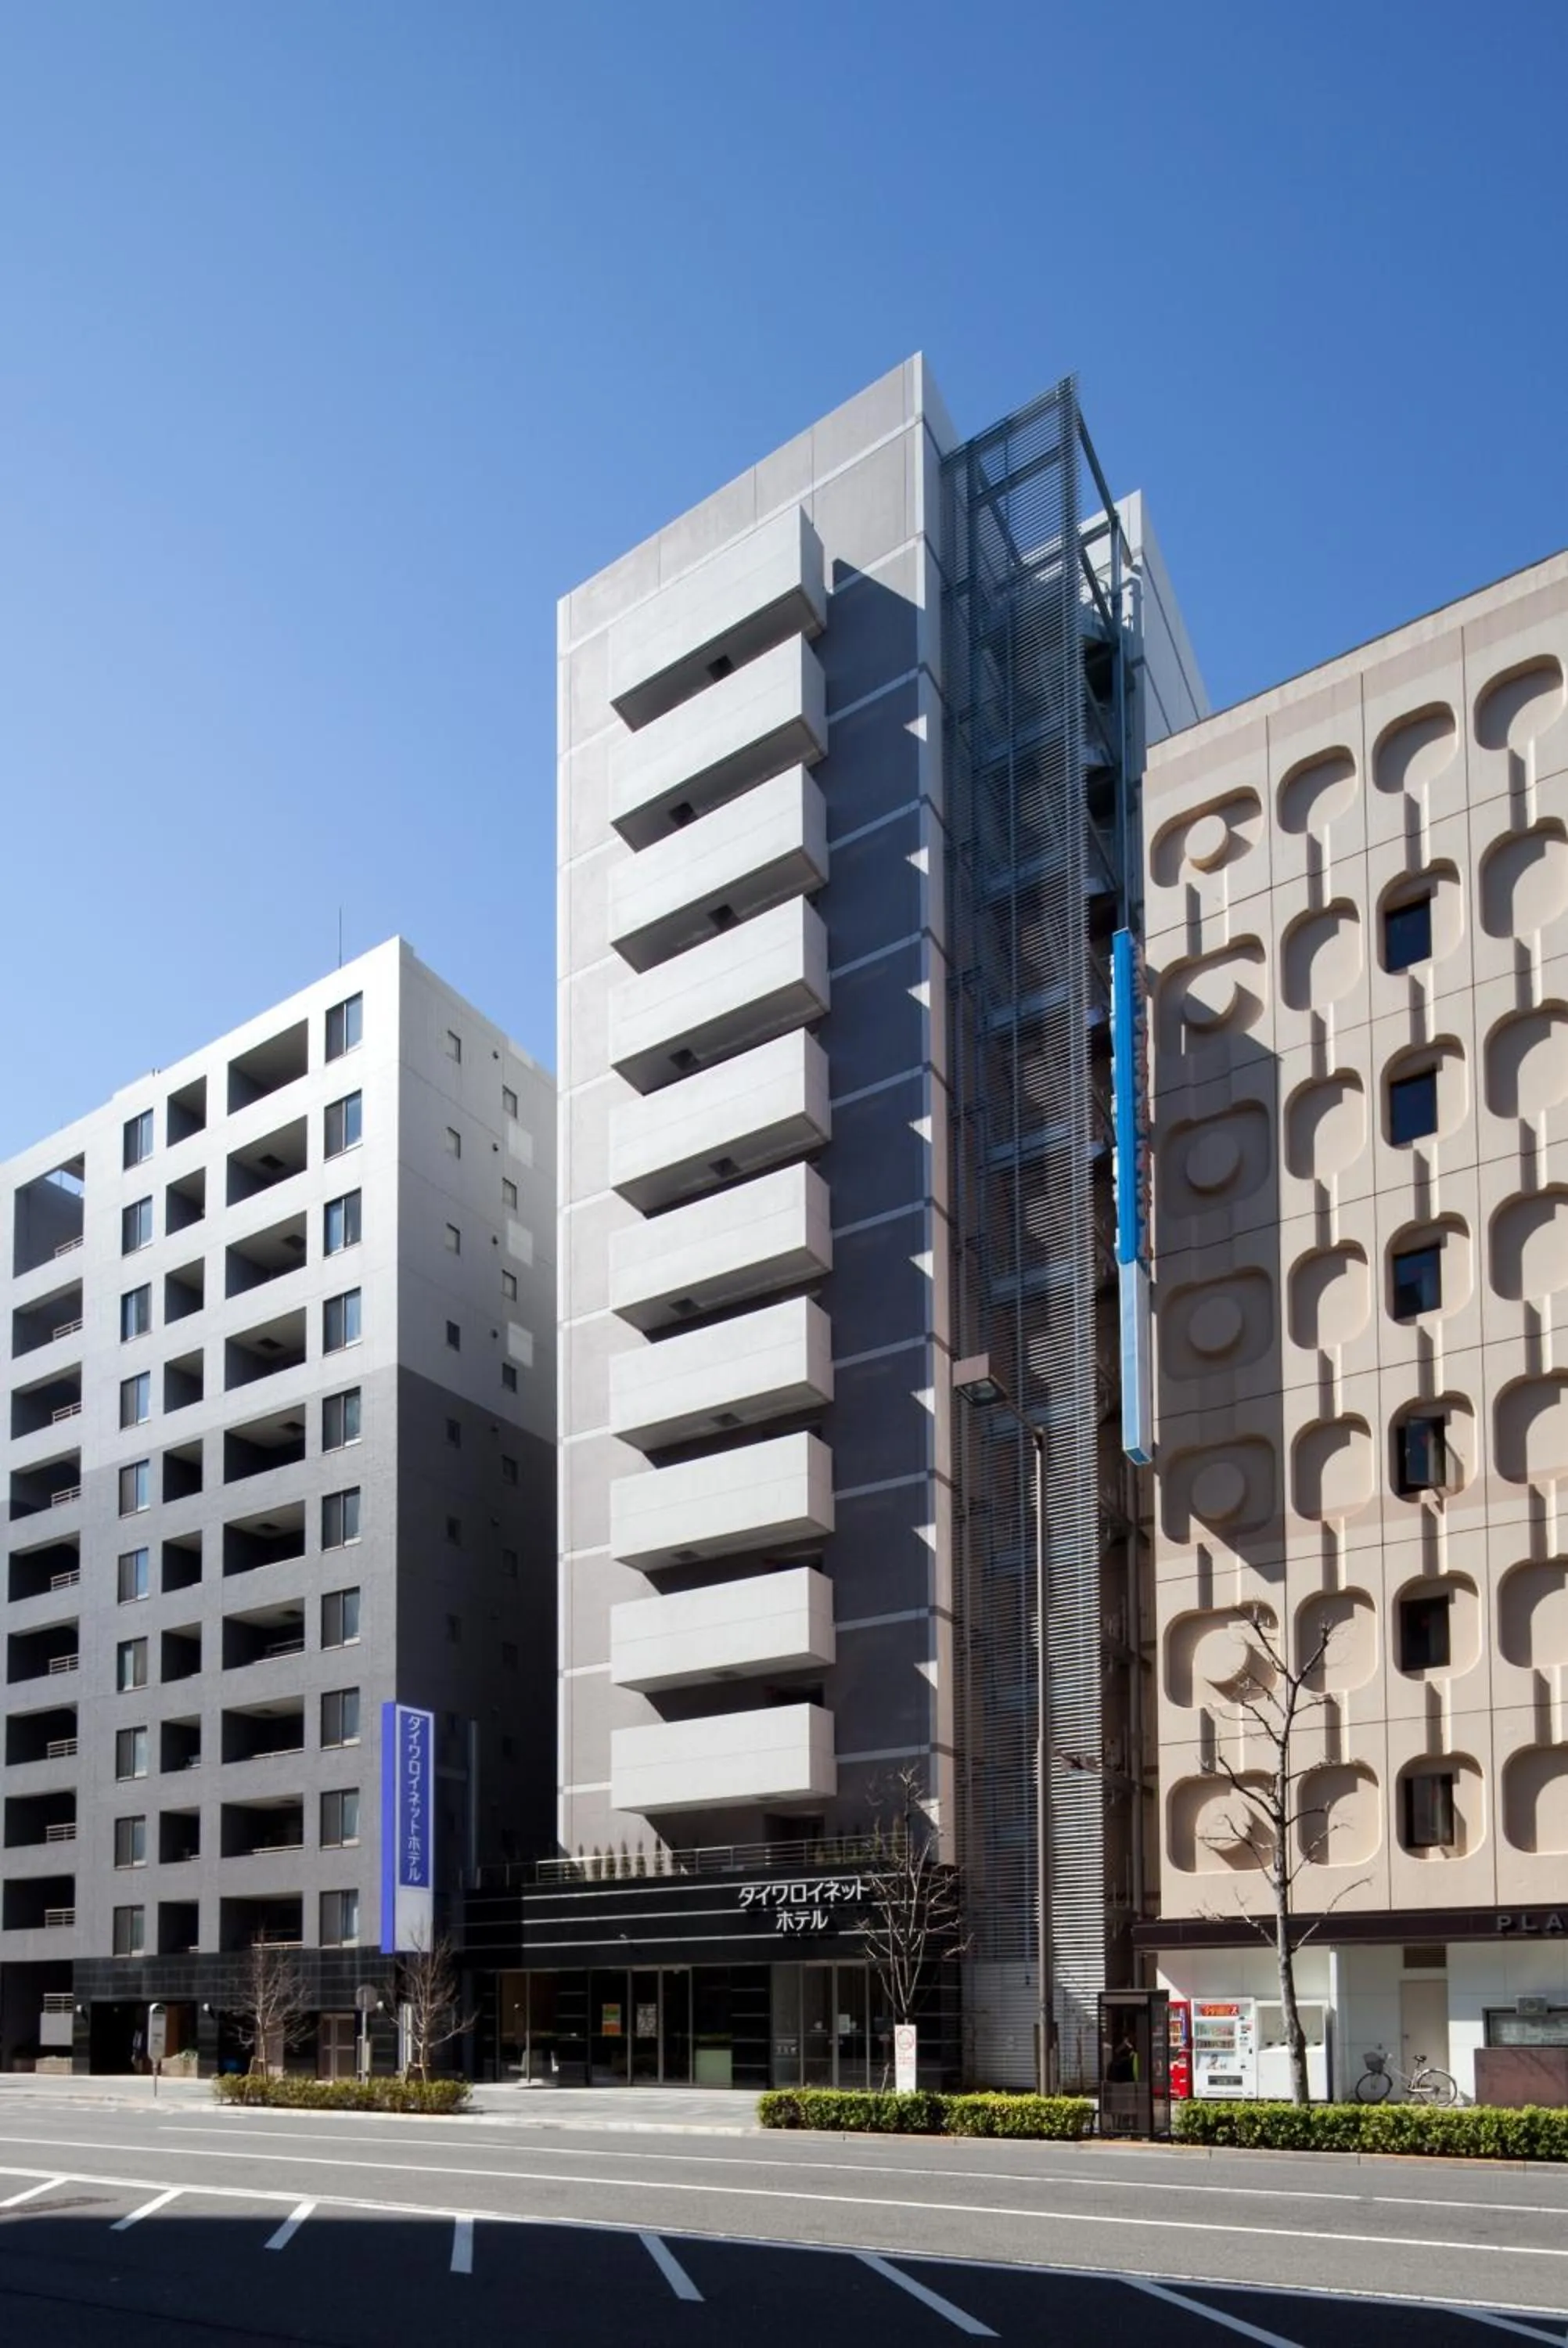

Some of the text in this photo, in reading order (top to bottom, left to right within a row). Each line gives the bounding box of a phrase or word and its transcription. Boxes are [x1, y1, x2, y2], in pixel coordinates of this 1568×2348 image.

[408, 1715, 425, 1882] ダイワロイネットホテル
[738, 1876, 870, 1907] ダイワロイネット
[776, 1909, 829, 1932] ホテル
[1496, 1912, 1564, 1932] PLA
